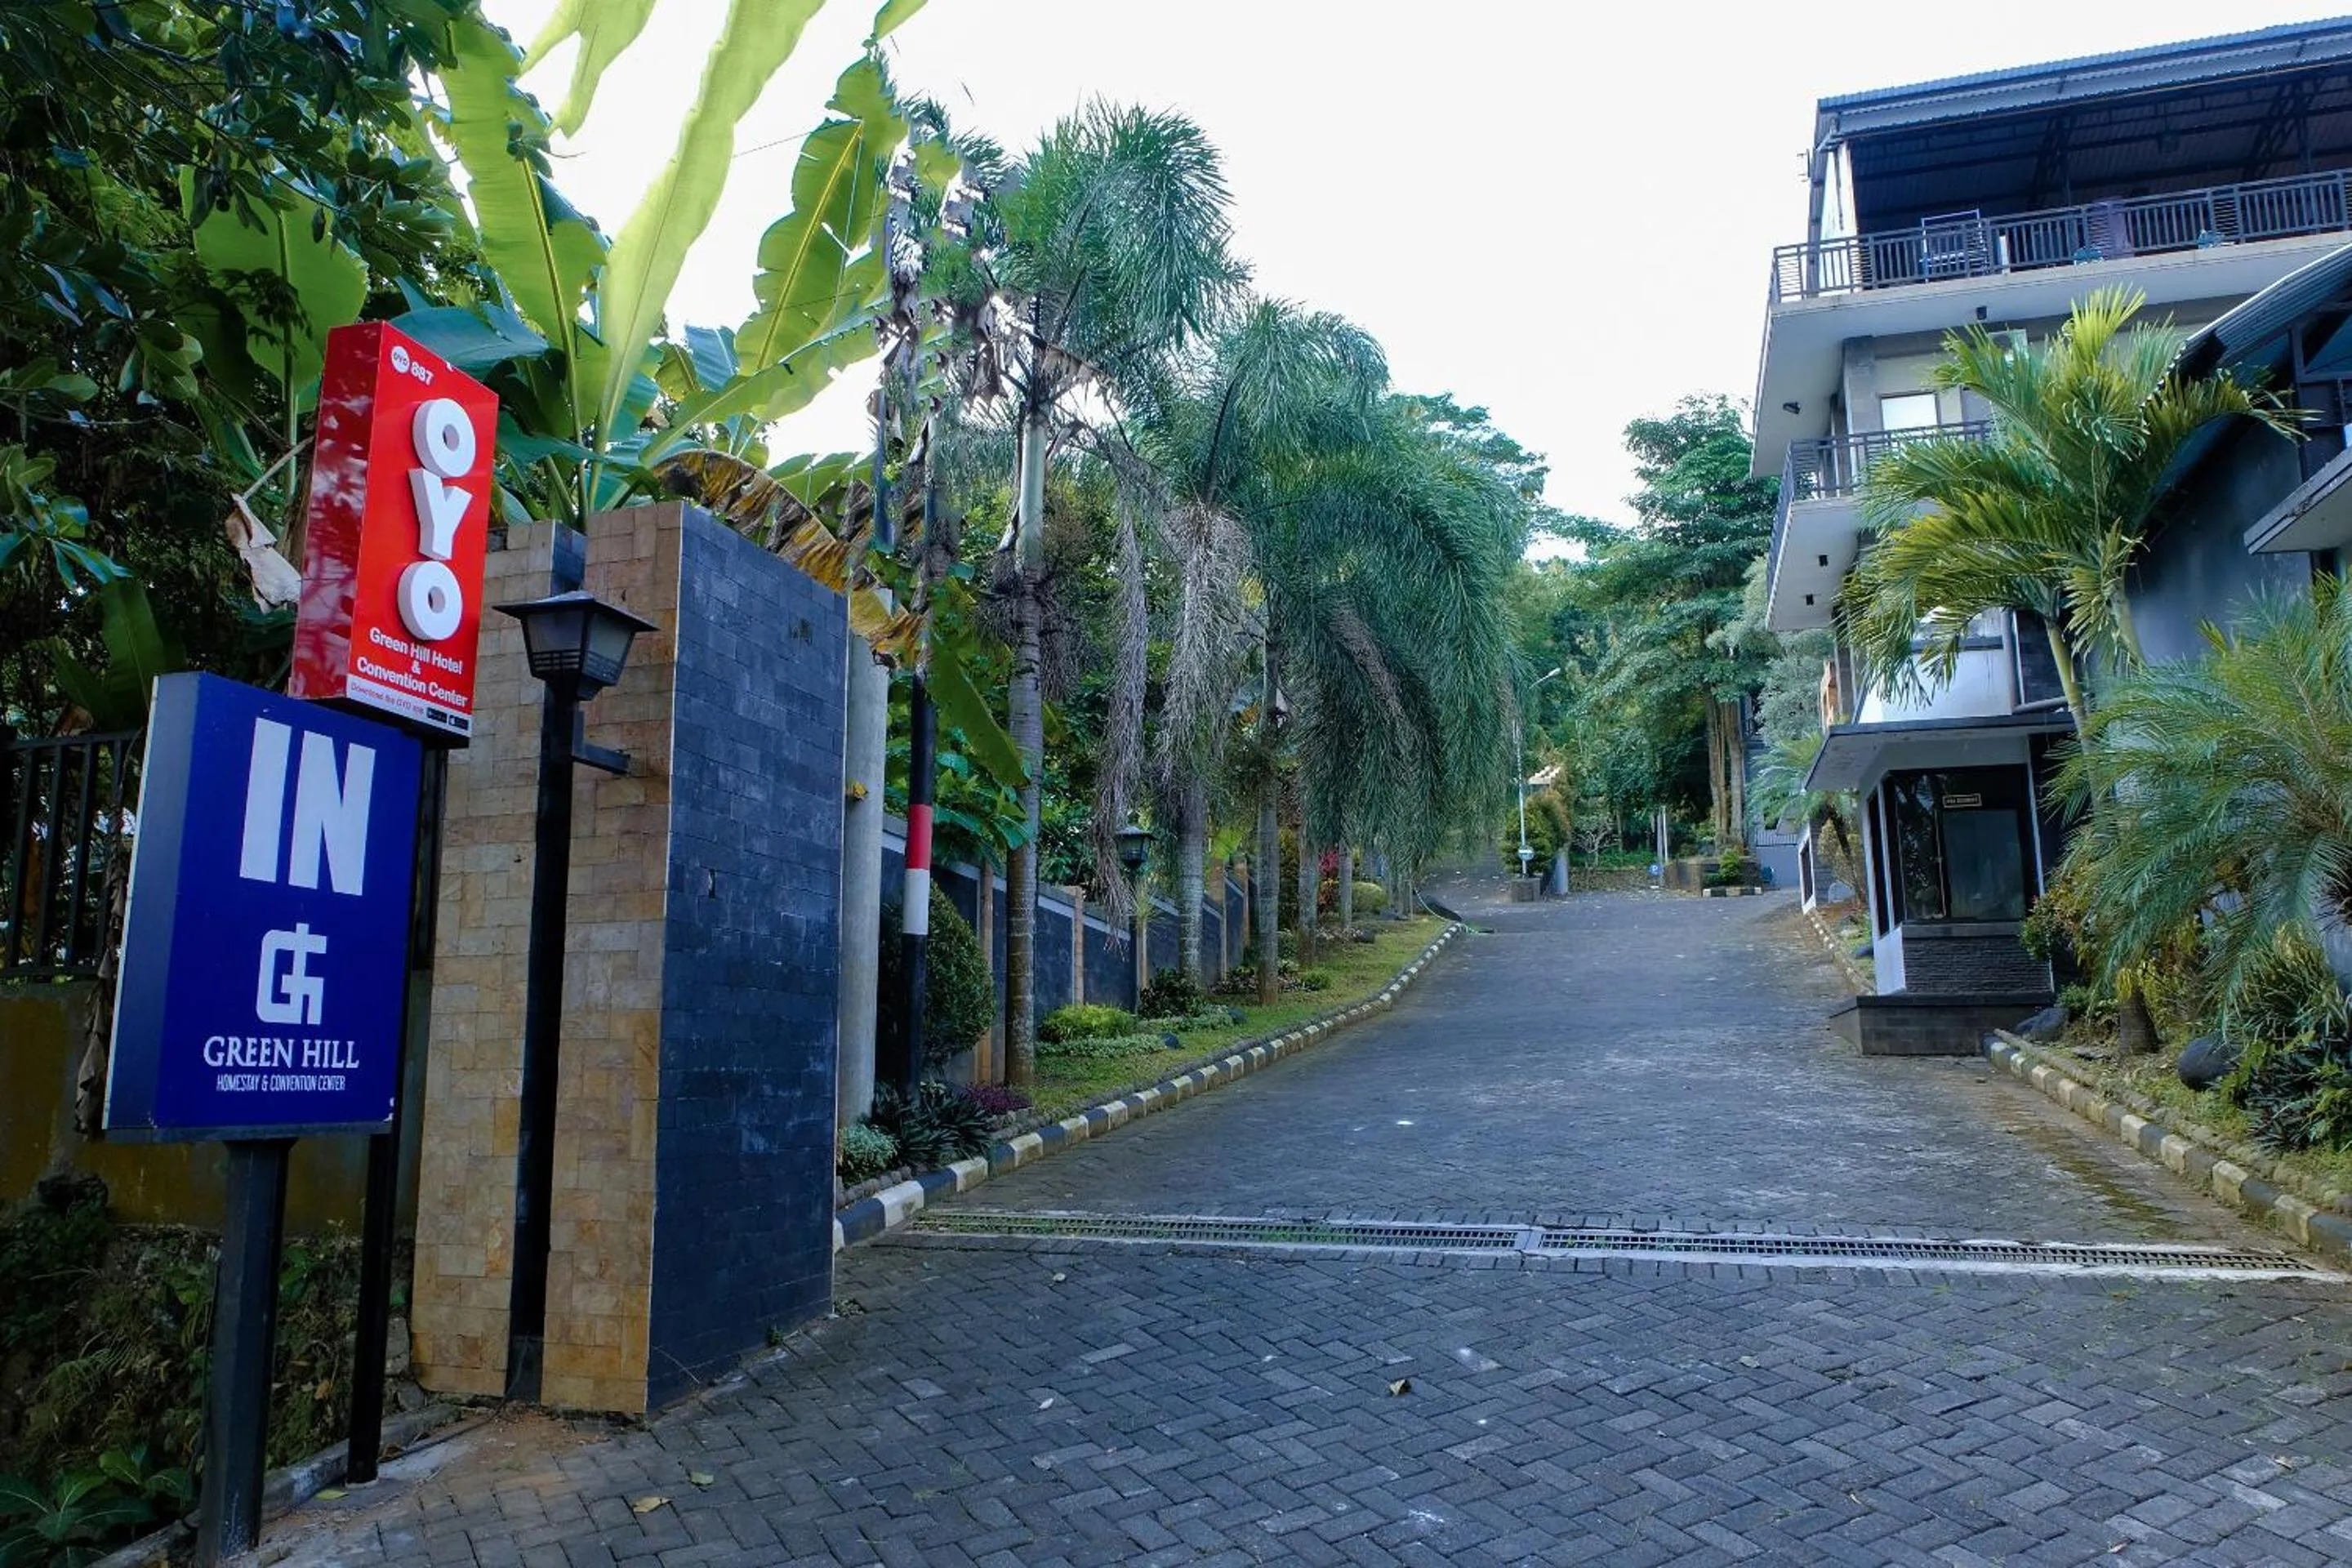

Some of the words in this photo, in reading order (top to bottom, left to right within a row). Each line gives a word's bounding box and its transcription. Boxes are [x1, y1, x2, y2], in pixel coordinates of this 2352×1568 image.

[397, 398, 477, 641] OYO
[369, 626, 408, 654] Green
[410, 643, 430, 663] Hill
[432, 650, 463, 675] Hotel
[412, 660, 421, 675] &
[357, 657, 426, 693] Convention
[429, 682, 468, 707] Center
[239, 717, 376, 896] IN
[203, 1036, 296, 1068] GREEN
[301, 1039, 360, 1068] HILL
[216, 1074, 261, 1091] HOMESTAY
[261, 1075, 268, 1091] &
[270, 1075, 317, 1091] CONVENTION
[318, 1075, 345, 1091] CENTER
